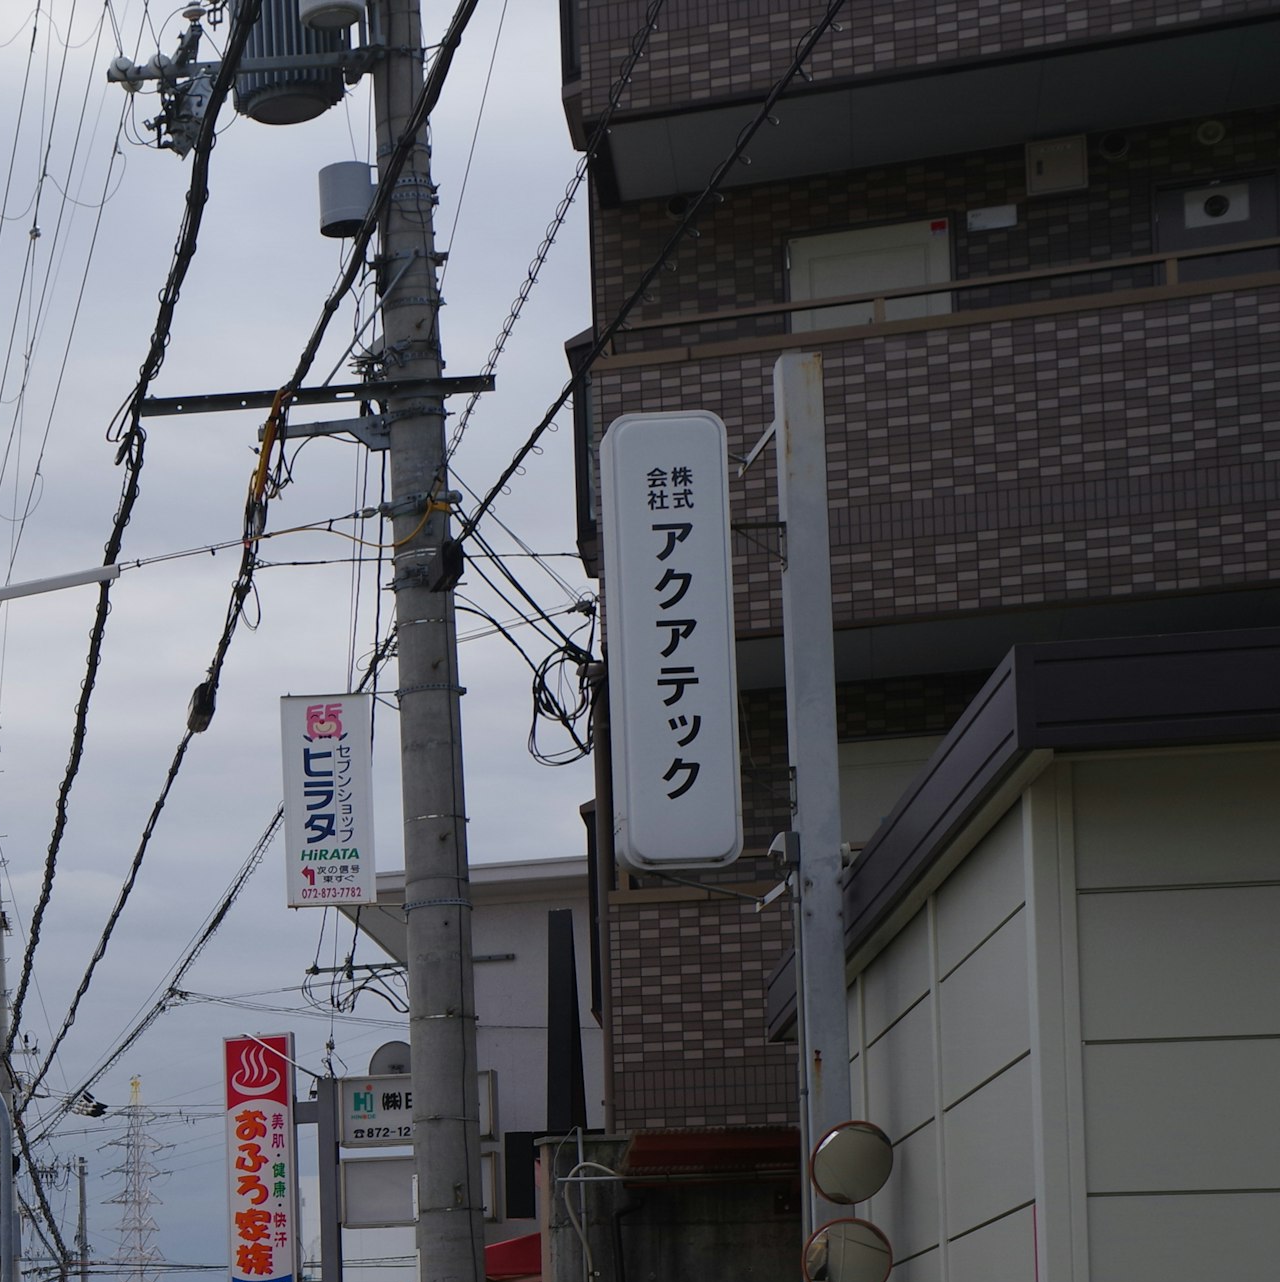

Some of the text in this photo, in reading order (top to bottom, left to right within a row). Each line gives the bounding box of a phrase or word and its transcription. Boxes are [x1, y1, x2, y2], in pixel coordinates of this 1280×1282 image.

[651, 522, 703, 800] アクアテック
[303, 747, 336, 844] ヒラタ
[336, 744, 353, 843] セブンショップ
[301, 848, 360, 861] HiRATA
[301, 887, 361, 899] 072-873-7782
[316, 865, 361, 875] 次の信号
[323, 875, 355, 883] 東すぐ
[234, 1109, 274, 1276] おふろ家族
[270, 1112, 287, 1248] 美肌・健康・快汗
